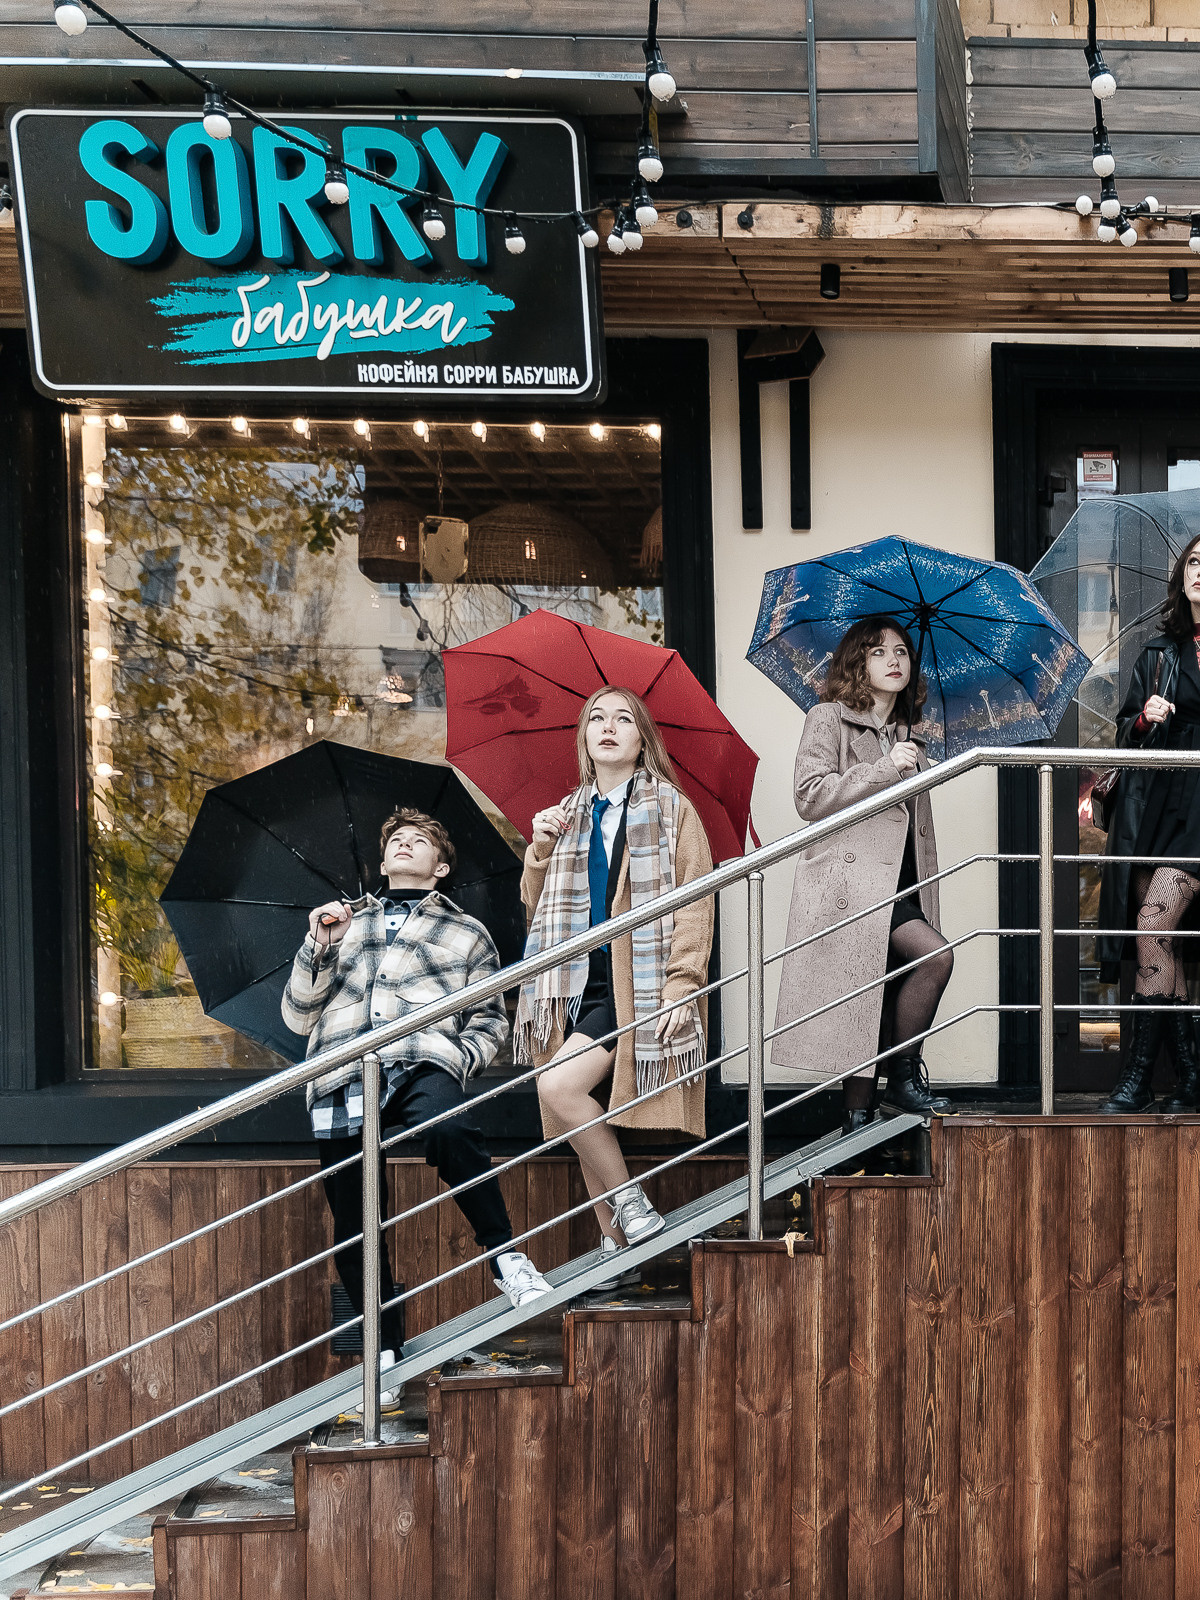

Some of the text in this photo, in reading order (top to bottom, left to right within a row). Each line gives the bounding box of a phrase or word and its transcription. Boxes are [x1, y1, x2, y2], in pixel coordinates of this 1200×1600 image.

[79, 119, 508, 266] SORRY
[231, 271, 468, 361] бабушка
[357, 360, 580, 385] КОФЕЙНЯ СОРРИ БАБУШКА
